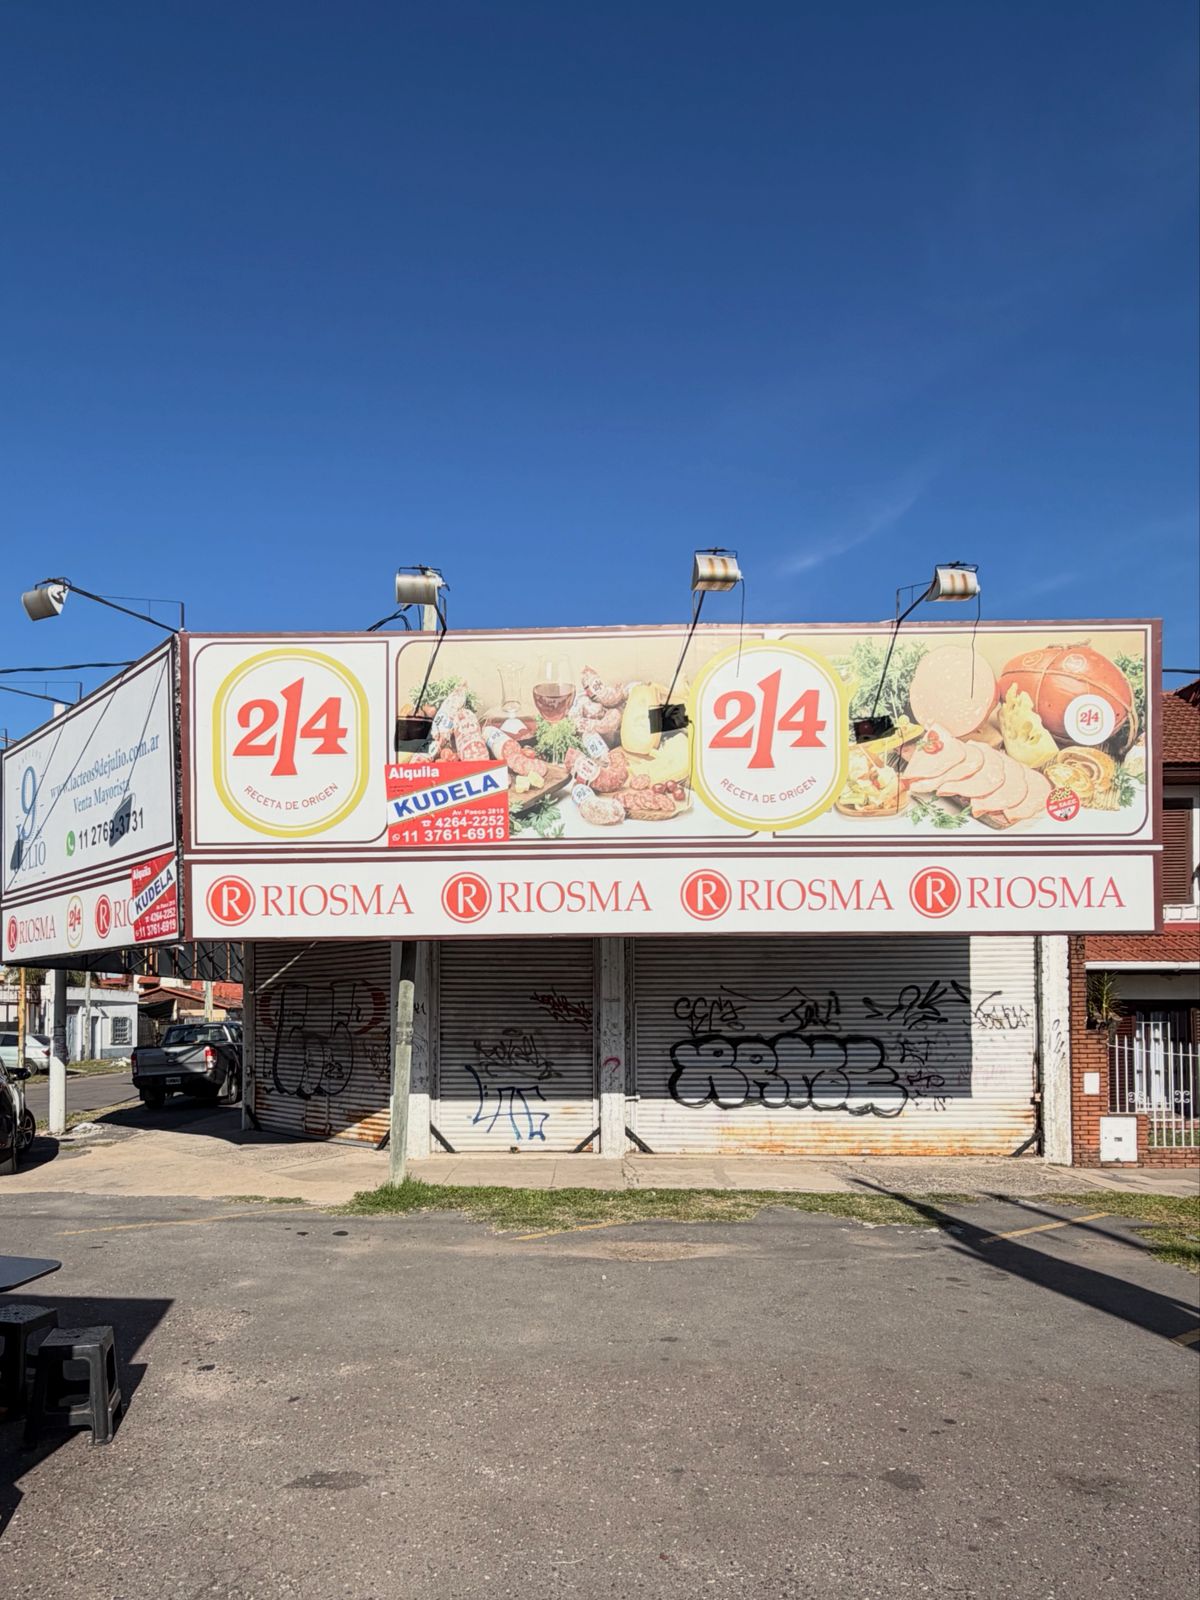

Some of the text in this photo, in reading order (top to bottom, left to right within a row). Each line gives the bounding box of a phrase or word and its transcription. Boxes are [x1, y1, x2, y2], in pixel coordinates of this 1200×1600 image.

[388, 766, 440, 781] Alquila
[73, 778, 130, 814] Venta Mayorista
[244, 783, 338, 810] RECETA DE ORIGEN
[394, 774, 500, 818] KUDELA
[720, 776, 817, 803] RECETA DE ORIGEN
[79, 807, 144, 850] 11 2769-3731
[402, 827, 505, 843] 11 3761-6919
[435, 815, 505, 828] 4264-2252
[135, 868, 174, 915] KUDELA
[261, 883, 414, 917] RIOSMA
[497, 880, 653, 913] RIOSMA
[737, 878, 894, 911] RIOSMA
[966, 876, 1127, 909] RIOSMA
[19, 915, 57, 944] RIOSMA
